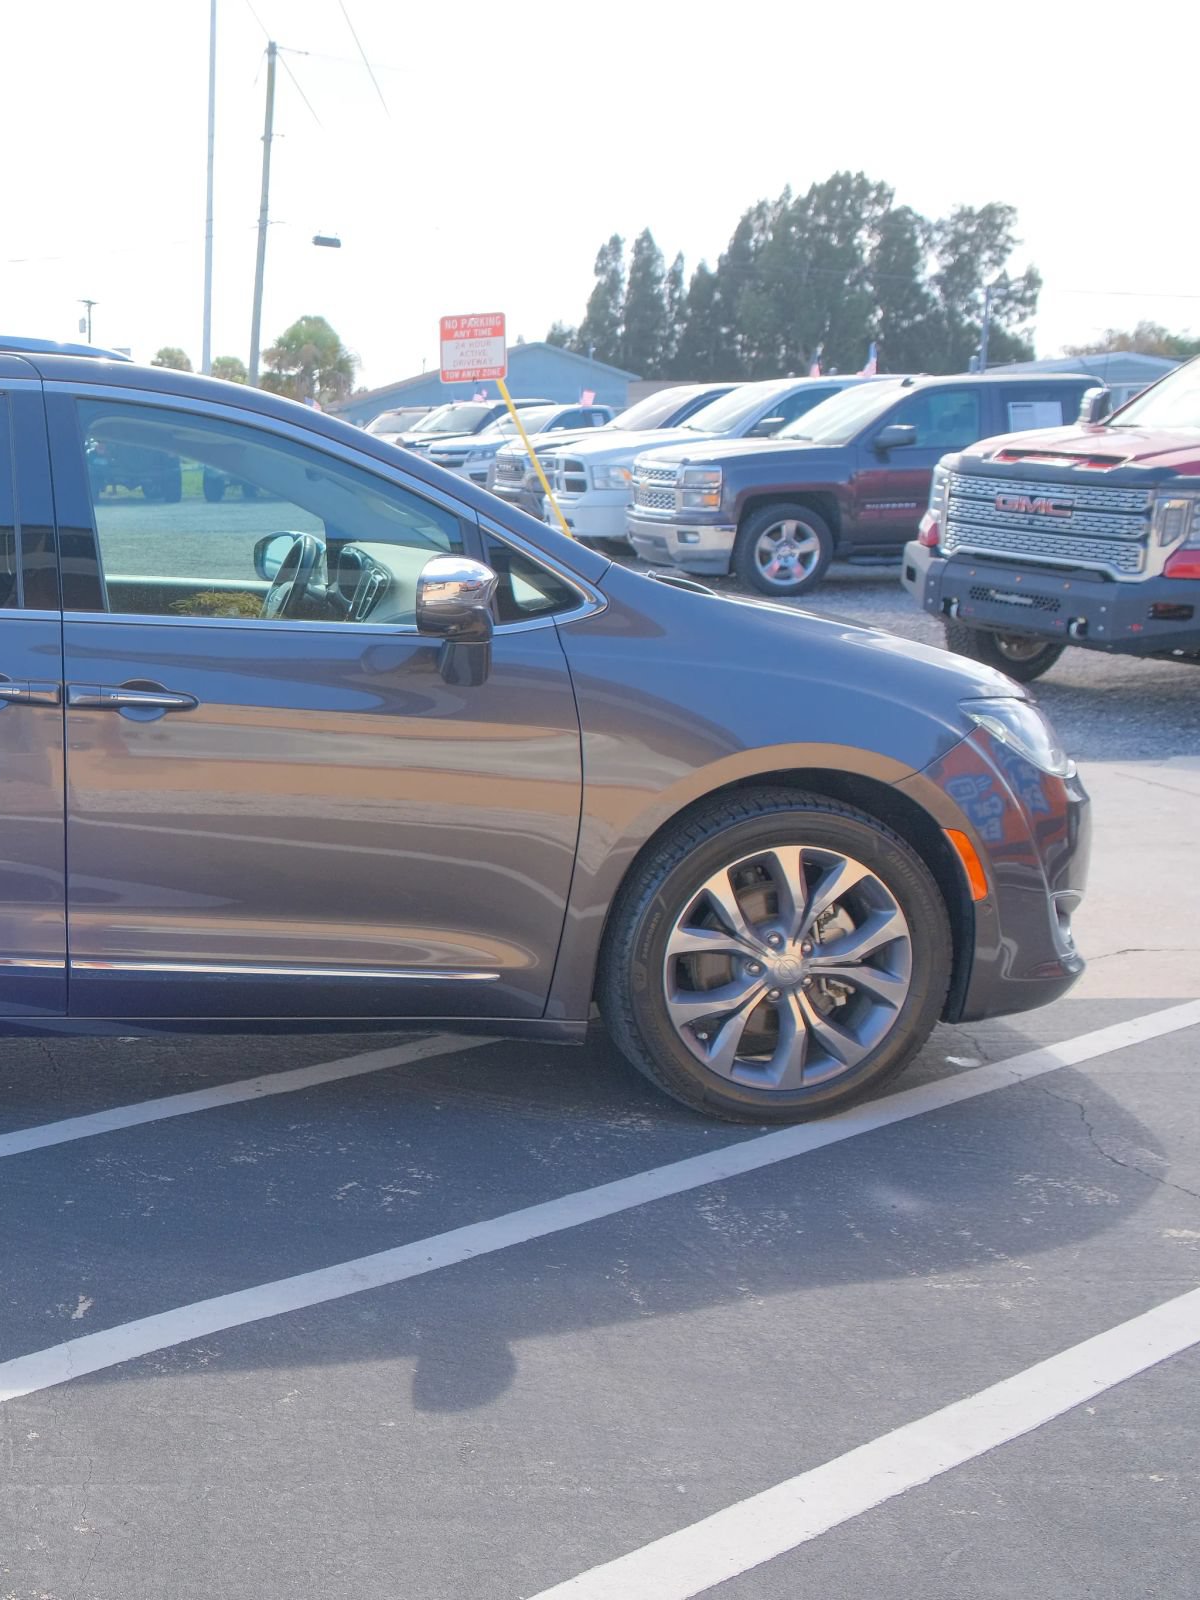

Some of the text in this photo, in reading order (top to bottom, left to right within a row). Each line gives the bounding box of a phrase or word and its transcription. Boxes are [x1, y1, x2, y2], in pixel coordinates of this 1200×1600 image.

[445, 316, 501, 329] NO PARKING
[453, 328, 493, 338] ANY TIME
[459, 350, 488, 358] ACTIVE
[453, 358, 494, 367] DRIVEWAY
[446, 368, 502, 379] TOW AWAY ZONE
[996, 494, 1073, 518] GMC
